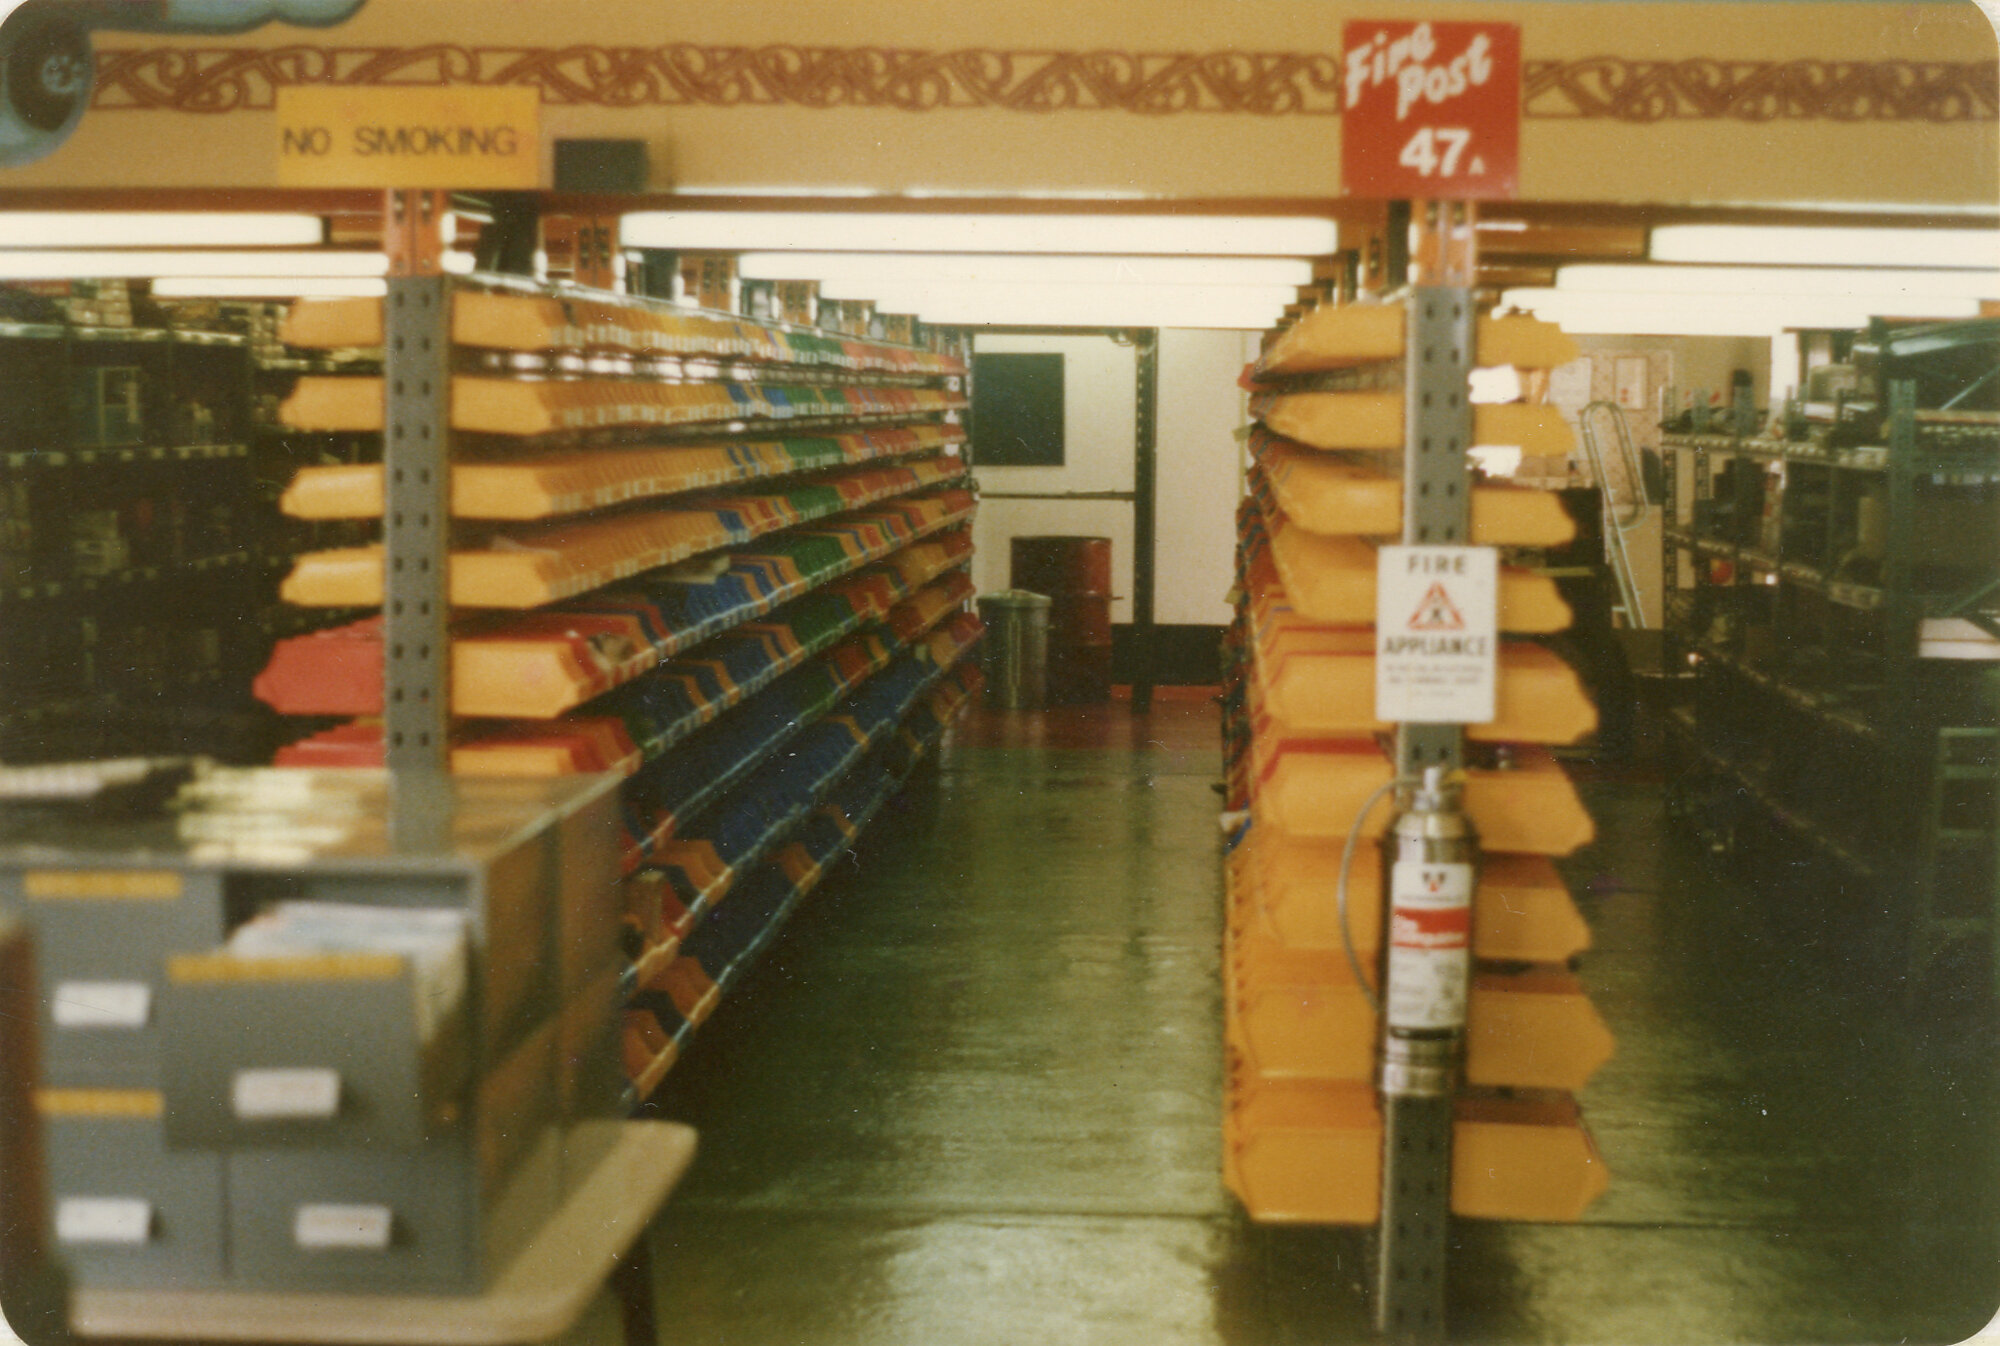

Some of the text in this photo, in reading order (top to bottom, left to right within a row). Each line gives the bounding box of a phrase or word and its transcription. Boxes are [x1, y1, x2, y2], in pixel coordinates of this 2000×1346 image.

[1346, 22, 1437, 109] Fire
[283, 126, 518, 157] NO SMOKING
[1407, 555, 1466, 574] FIRE
[1385, 636, 1486, 656] APPLIANCE
